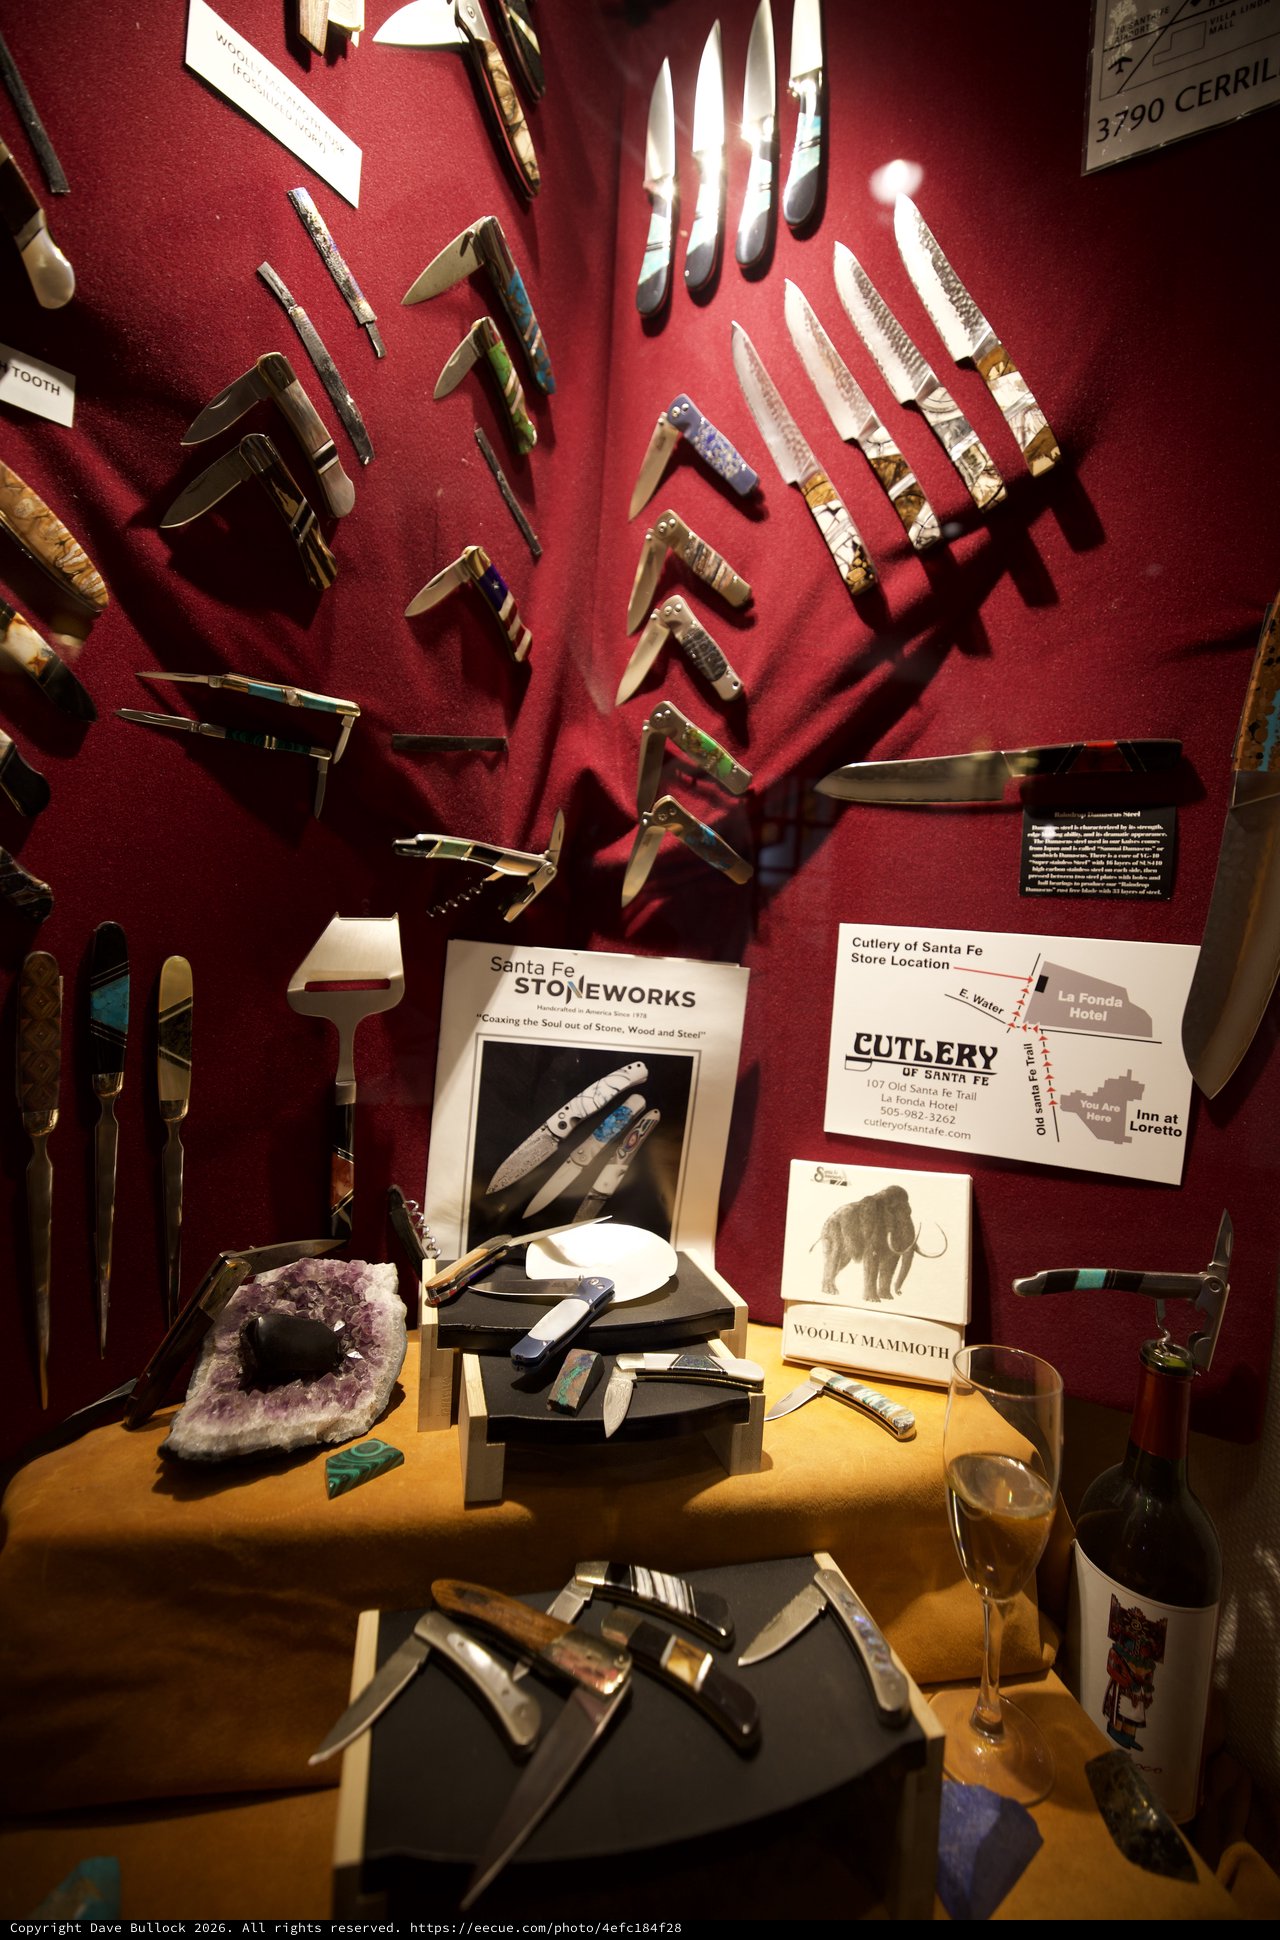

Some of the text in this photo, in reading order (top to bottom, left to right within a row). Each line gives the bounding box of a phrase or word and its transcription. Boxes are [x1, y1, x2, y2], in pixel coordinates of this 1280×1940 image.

[1210, 9, 1236, 25] VILLA
[1240, 0, 1271, 14] LINDA
[1209, 19, 1234, 35] MALL
[215, 30, 262, 77] WOOLLY
[232, 62, 293, 121] (FOSSILIZED
[1095, 57, 1280, 143] 3790 CERRIL
[11, 366, 60, 396] TOOTH
[852, 937, 983, 956] Cutlery of Santa Fe
[490, 956, 575, 978] Santa Fe
[851, 952, 950, 970] Store Location
[514, 974, 697, 1008] STONEWORKS
[958, 988, 1005, 1015] E. Water
[1058, 990, 1124, 1009] La Fonda
[536, 1004, 577, 1014] Handcrafted
[586, 1008, 612, 1016] America
[613, 1010, 630, 1018] Since
[1069, 1007, 1108, 1022] Hotel
[476, 1013, 706, 1039] "Coaxing the Soul out of Stone, Wood and Steel"
[853, 1032, 998, 1070] CUTLERY
[902, 1067, 990, 1087] OF SANTA FE
[866, 1079, 978, 1101] 107 Old Santa Fe Trail
[1023, 1043, 1046, 1136] Old santa Fe Trail
[881, 1093, 958, 1112] La Fonda Hotel
[1080, 1099, 1121, 1113] You Are
[880, 1106, 957, 1125] 505-982-3262
[1086, 1111, 1112, 1123] Here
[1136, 1109, 1179, 1125] Inn at
[863, 1117, 972, 1141] cutleryofsantafe.com
[1129, 1120, 1183, 1137] Loretto
[793, 1323, 950, 1360] WOOLLY MAMMOTH
